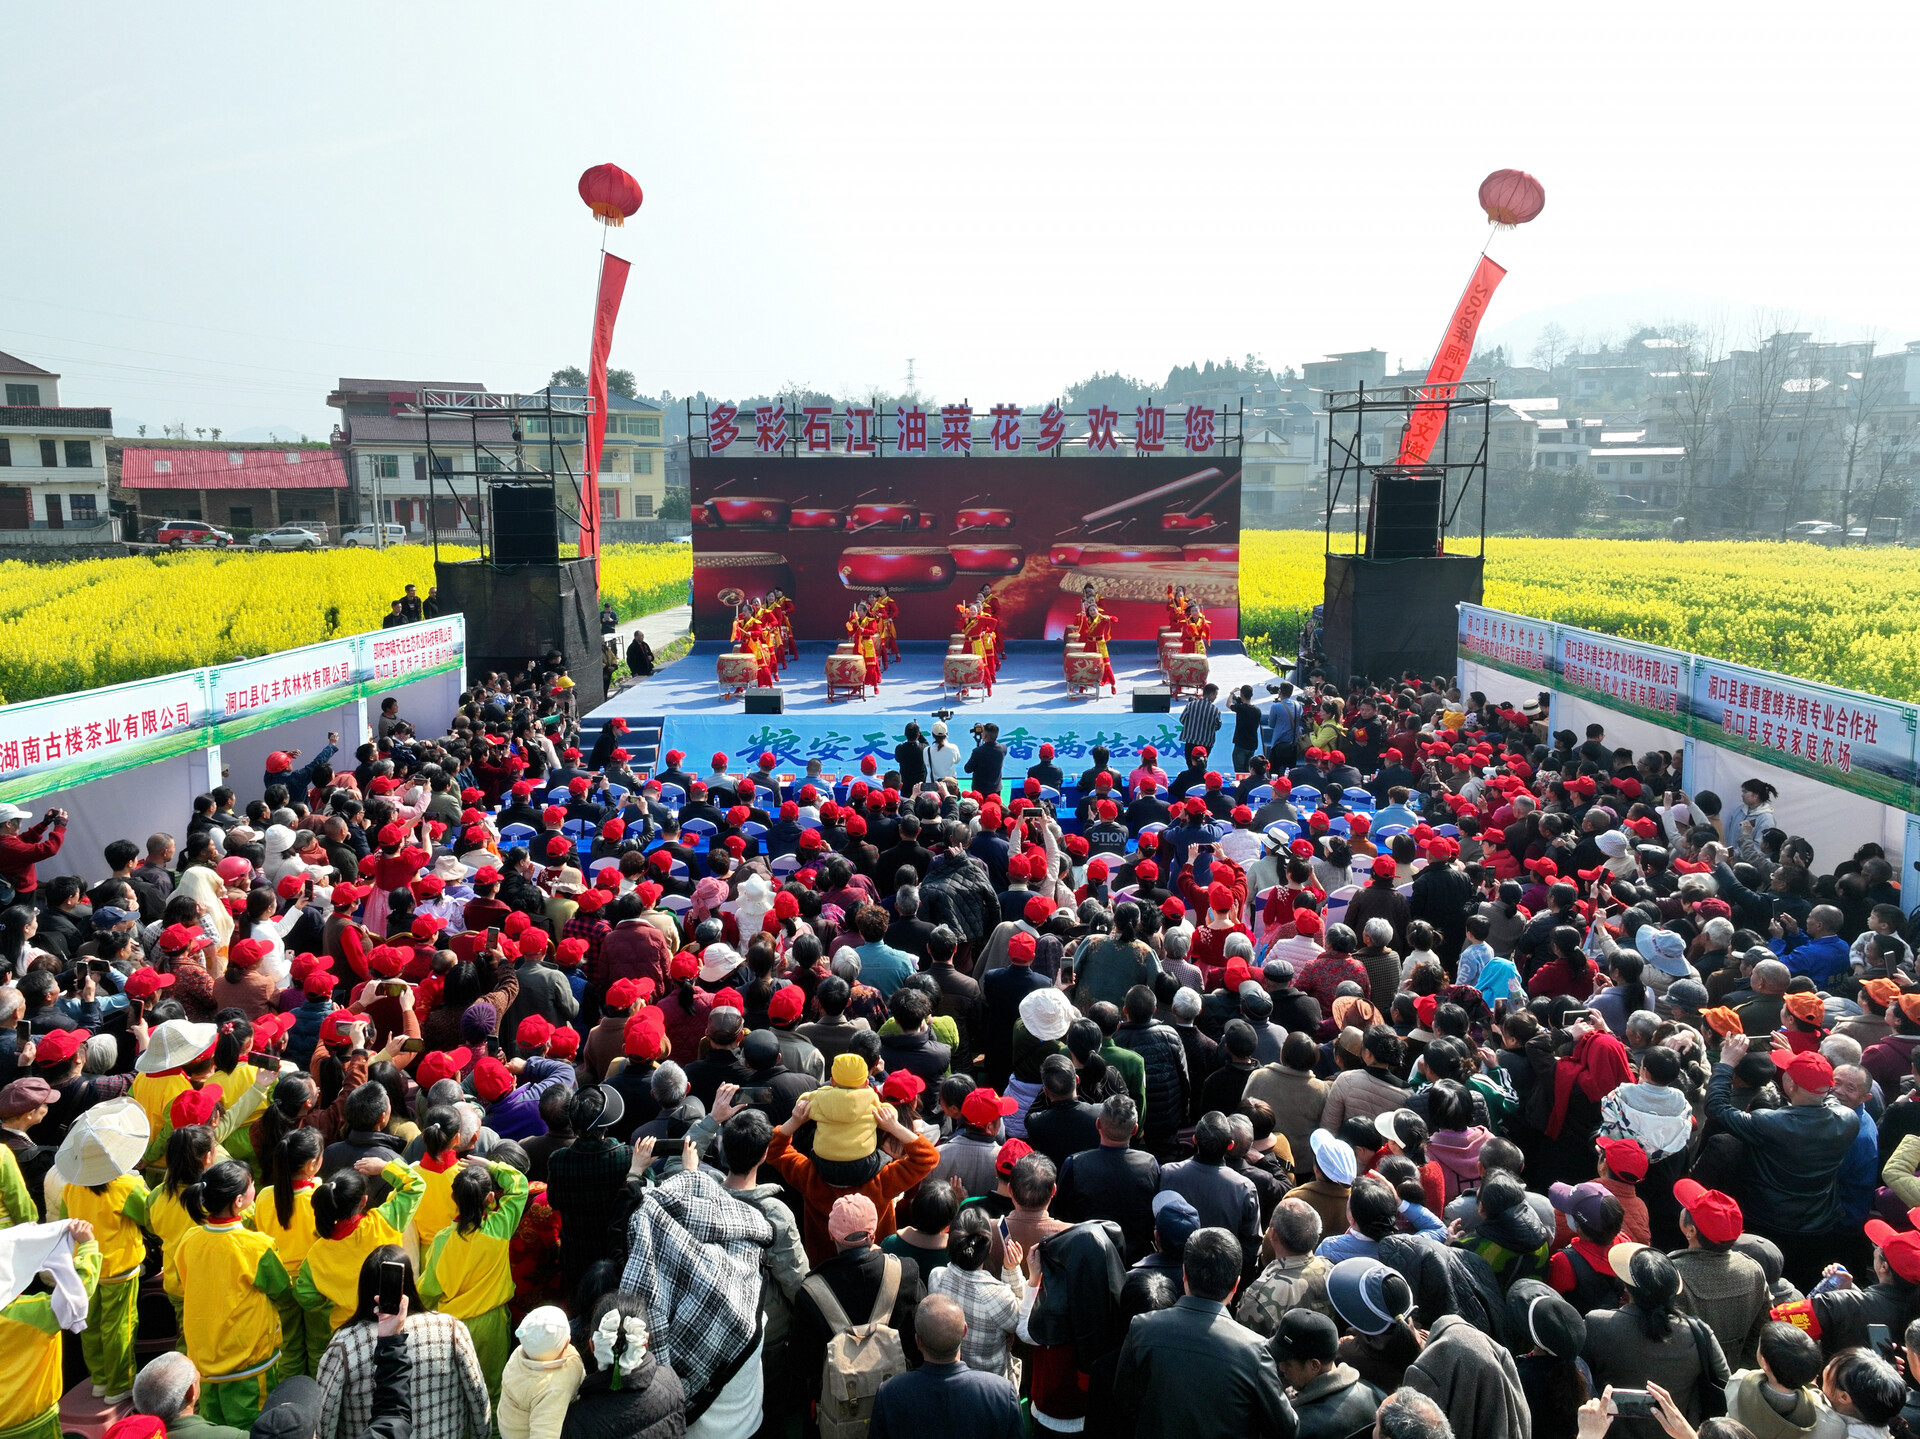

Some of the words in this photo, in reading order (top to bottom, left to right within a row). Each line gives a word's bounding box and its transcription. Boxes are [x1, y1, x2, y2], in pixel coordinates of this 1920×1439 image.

[707, 403, 1217, 454] 多彩石江油菜花乡欢迎您
[225, 661, 350, 715] 洞口县亿丰农林牧有限公司
[1564, 638, 1679, 689] 洞口县华清生态农业科技有限公司
[0, 702, 191, 773] 湖南古楼茶业有限公司
[1721, 708, 1852, 773] 洞口县安安家庭农场
[1091, 832, 1127, 843] STION
